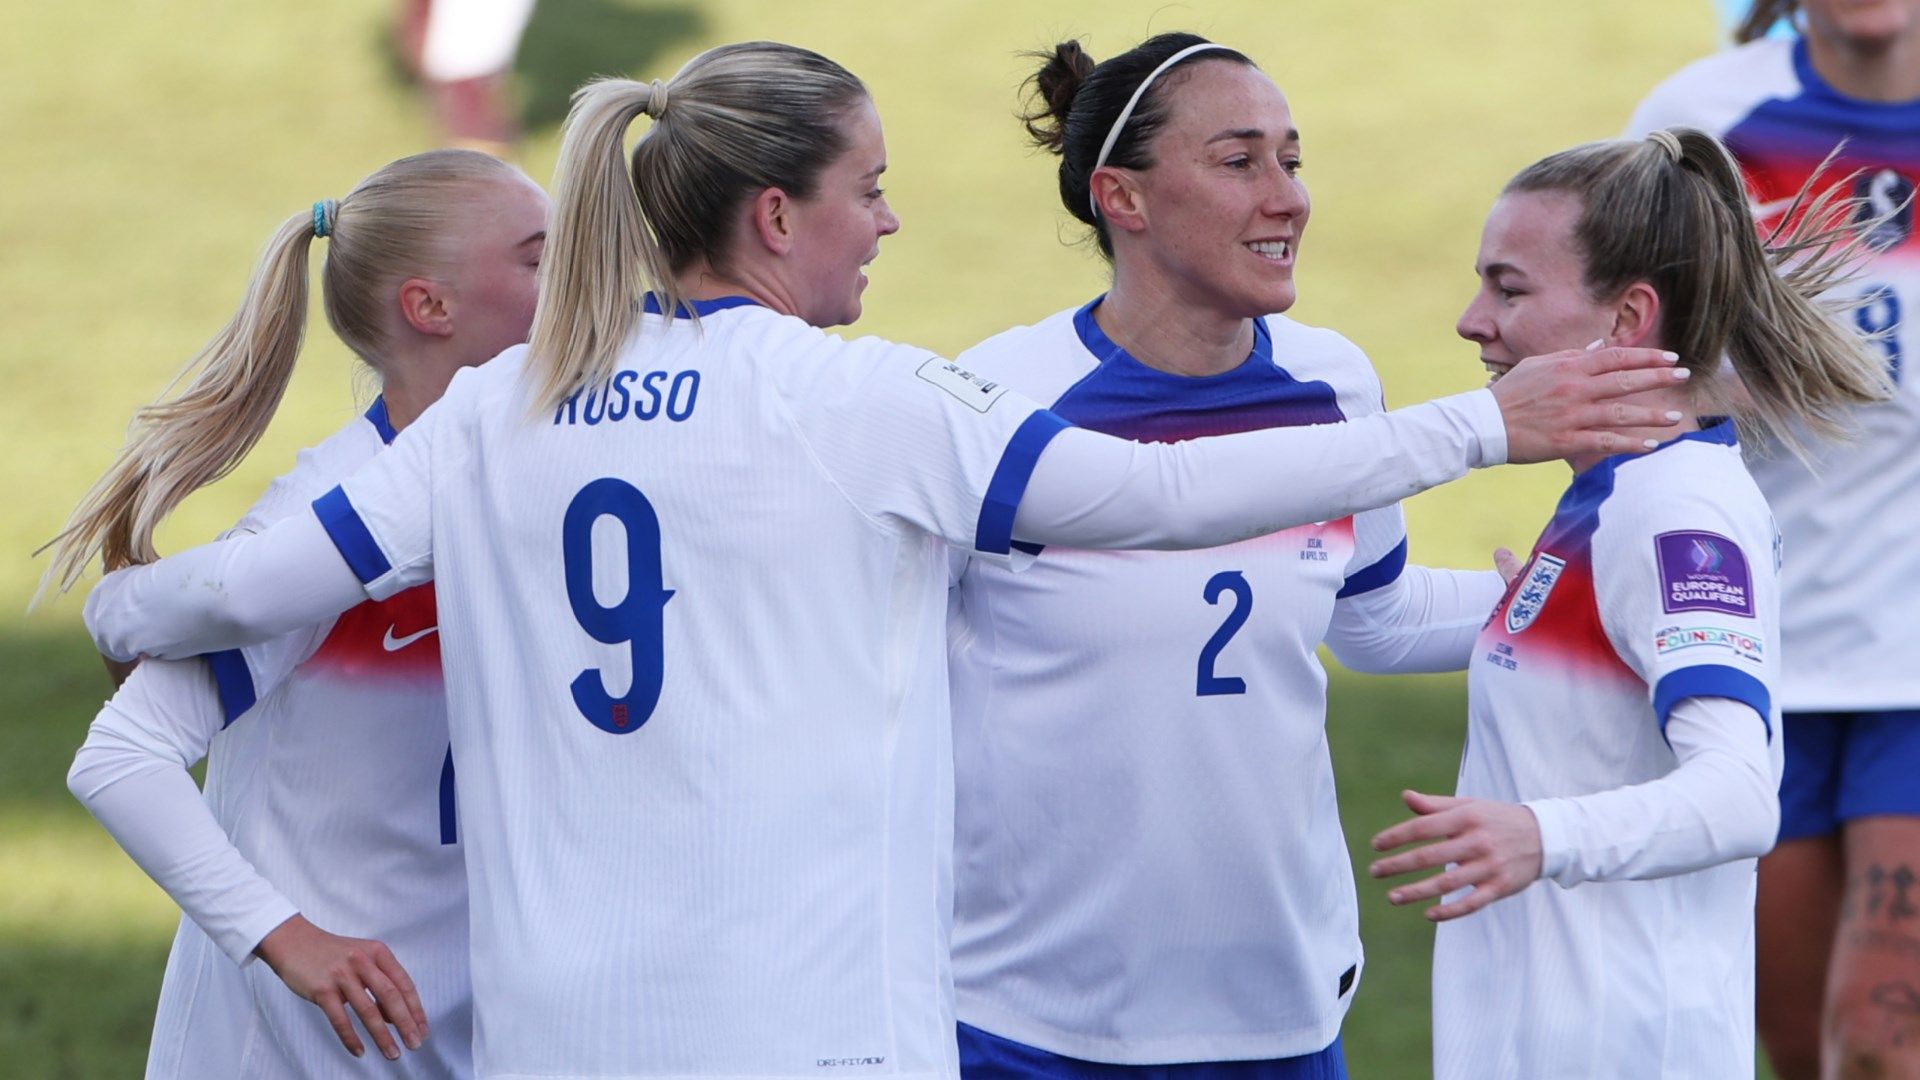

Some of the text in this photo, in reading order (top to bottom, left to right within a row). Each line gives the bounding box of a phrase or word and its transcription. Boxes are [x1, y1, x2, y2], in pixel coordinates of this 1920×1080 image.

[1671, 591, 1747, 607] QUALIFIERS
[1672, 581, 1745, 596] EUROPEAN
[563, 477, 676, 734] 9
[1196, 570, 1253, 697] 2
[1656, 630, 1763, 653] FOUNDATION
